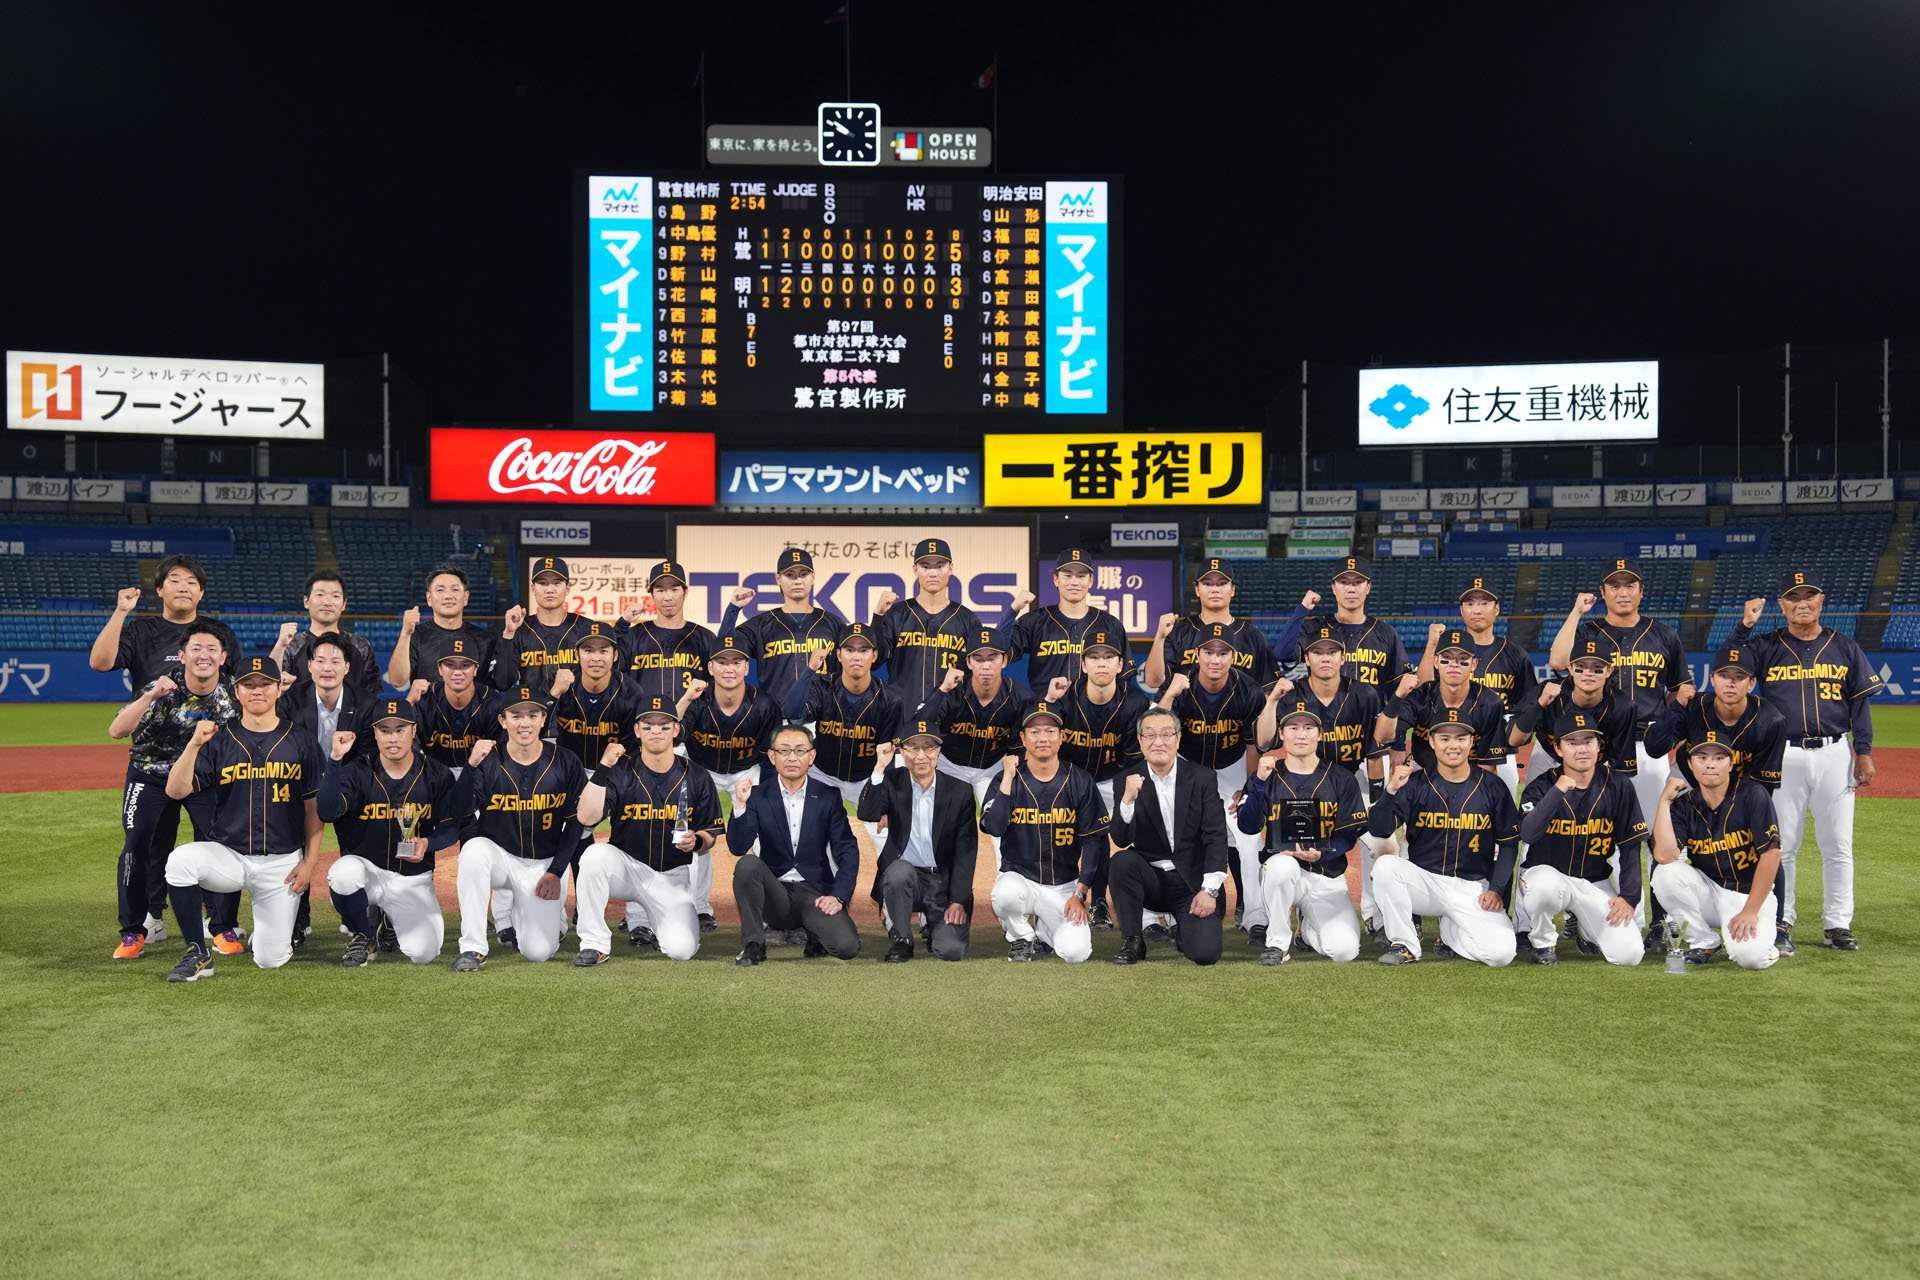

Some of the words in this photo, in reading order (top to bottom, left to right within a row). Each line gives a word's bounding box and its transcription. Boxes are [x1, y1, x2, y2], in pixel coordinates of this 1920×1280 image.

[929, 133, 977, 147] OPEN
[929, 149, 977, 160] HOUSE
[730, 182, 766, 196] TIME
[773, 183, 817, 197] JUDGE
[825, 183, 835, 196] B
[907, 185, 925, 197] AV
[983, 186, 1043, 202] 明治安田
[603, 203, 639, 212] マイナビ
[730, 197, 766, 210] 2:54
[825, 198, 836, 210] S
[907, 199, 925, 211] HR
[658, 206, 668, 219] 6
[982, 209, 991, 222] 9
[1060, 208, 1094, 217] マイナビ
[658, 227, 668, 239] 4
[982, 230, 991, 242] 3
[658, 247, 668, 260] 9
[762, 242, 769, 260] 1
[782, 242, 789, 260] 1
[801, 242, 812, 260] 0
[822, 243, 833, 260] 0
[842, 243, 853, 260] 0
[865, 243, 872, 260] 1
[883, 243, 894, 260] 0
[903, 243, 914, 260] 0
[924, 243, 935, 260] 2
[950, 243, 961, 261] 5
[982, 250, 991, 263] 8
[658, 268, 668, 280] D
[982, 271, 991, 284] 6
[762, 277, 769, 294] 1
[780, 277, 791, 294] 2
[801, 277, 812, 294] 0
[822, 277, 833, 294] 0
[842, 277, 853, 294] 0
[863, 277, 874, 294] 0
[883, 278, 894, 294] 0
[903, 278, 914, 294] 0
[924, 278, 935, 294] 0
[950, 277, 961, 295] 3
[658, 289, 668, 301] 5
[982, 292, 991, 304] D
[600, 230, 643, 396] マイナビ
[658, 309, 668, 322] 7
[982, 312, 991, 324] 7
[1056, 235, 1098, 398] マイナビ
[827, 320, 874, 333] 第97回
[658, 330, 668, 342] 8
[793, 335, 907, 348] 都市対抗野球大会
[982, 332, 991, 345] H
[658, 350, 668, 363] 2
[800, 349, 900, 363] 東京都二次予選
[982, 353, 991, 365] H
[658, 371, 668, 383] 3
[982, 373, 991, 386] 4
[658, 392, 668, 404] P
[794, 387, 907, 409] 鷺宮製作所
[982, 394, 991, 405] P
[1442, 382, 1649, 424] 住友重機械
[95, 388, 311, 429] フージャース
[210, 450, 222, 463] N
[368, 453, 382, 467] M
[488, 437, 668, 495] Coca-Cola
[1002, 440, 1245, 500] 一番搾り
[1313, 459, 1320, 472] L
[1466, 457, 1476, 470] K
[728, 462, 971, 494] パラマウントベッド
[521, 527, 589, 540] TEKNOS
[1112, 530, 1177, 541] TEKNOS
[545, 558, 554, 569] S
[1616, 560, 1626, 570] S
[1794, 572, 1804, 584] S
[252, 658, 262, 671] S
[941, 653, 958, 670] 13
[1360, 666, 1378, 685] 20
[1636, 669, 1659, 688] 57
[388, 702, 398, 714] S
[1706, 731, 1716, 743] S
[858, 742, 876, 758] 15
[1340, 743, 1363, 762] 27
[272, 783, 290, 802] 14
[127, 782, 145, 829] MoveSport
[542, 812, 552, 830] 9
[1055, 828, 1074, 846] 56
[1469, 834, 1479, 852] 4
[1589, 838, 1612, 856] 28
[1734, 849, 1759, 870] 24
